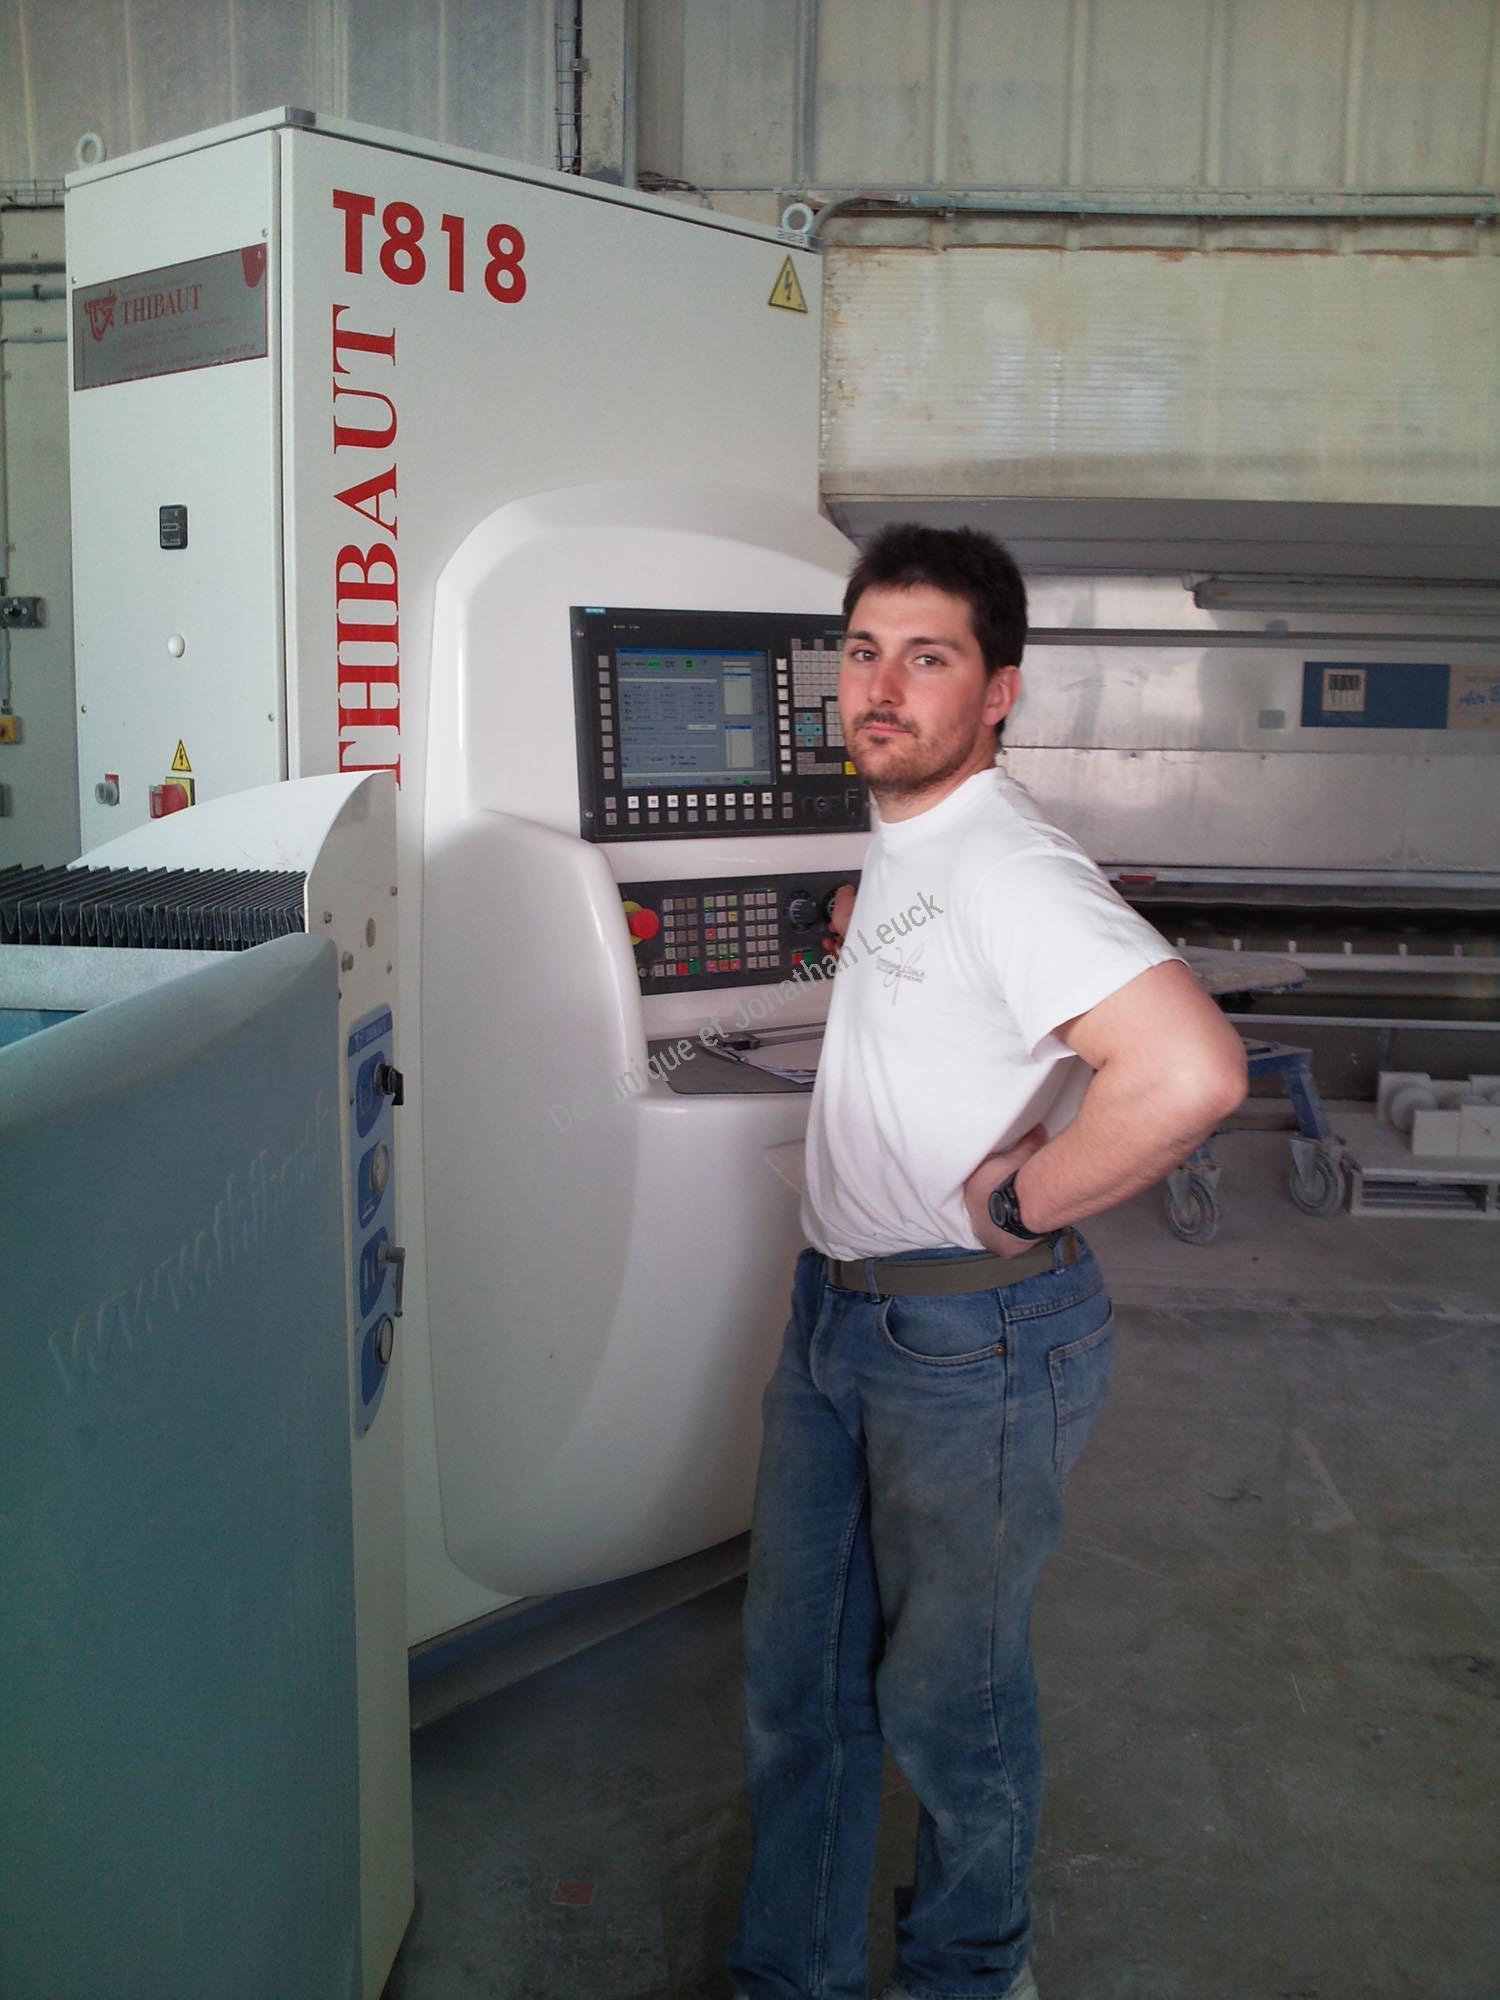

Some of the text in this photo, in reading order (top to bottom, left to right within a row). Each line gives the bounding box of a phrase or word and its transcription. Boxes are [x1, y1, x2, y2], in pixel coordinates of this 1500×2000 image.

[332, 188, 528, 304] T818
[120, 284, 203, 326] THIBAUT
[332, 304, 402, 791] THIBAUT
